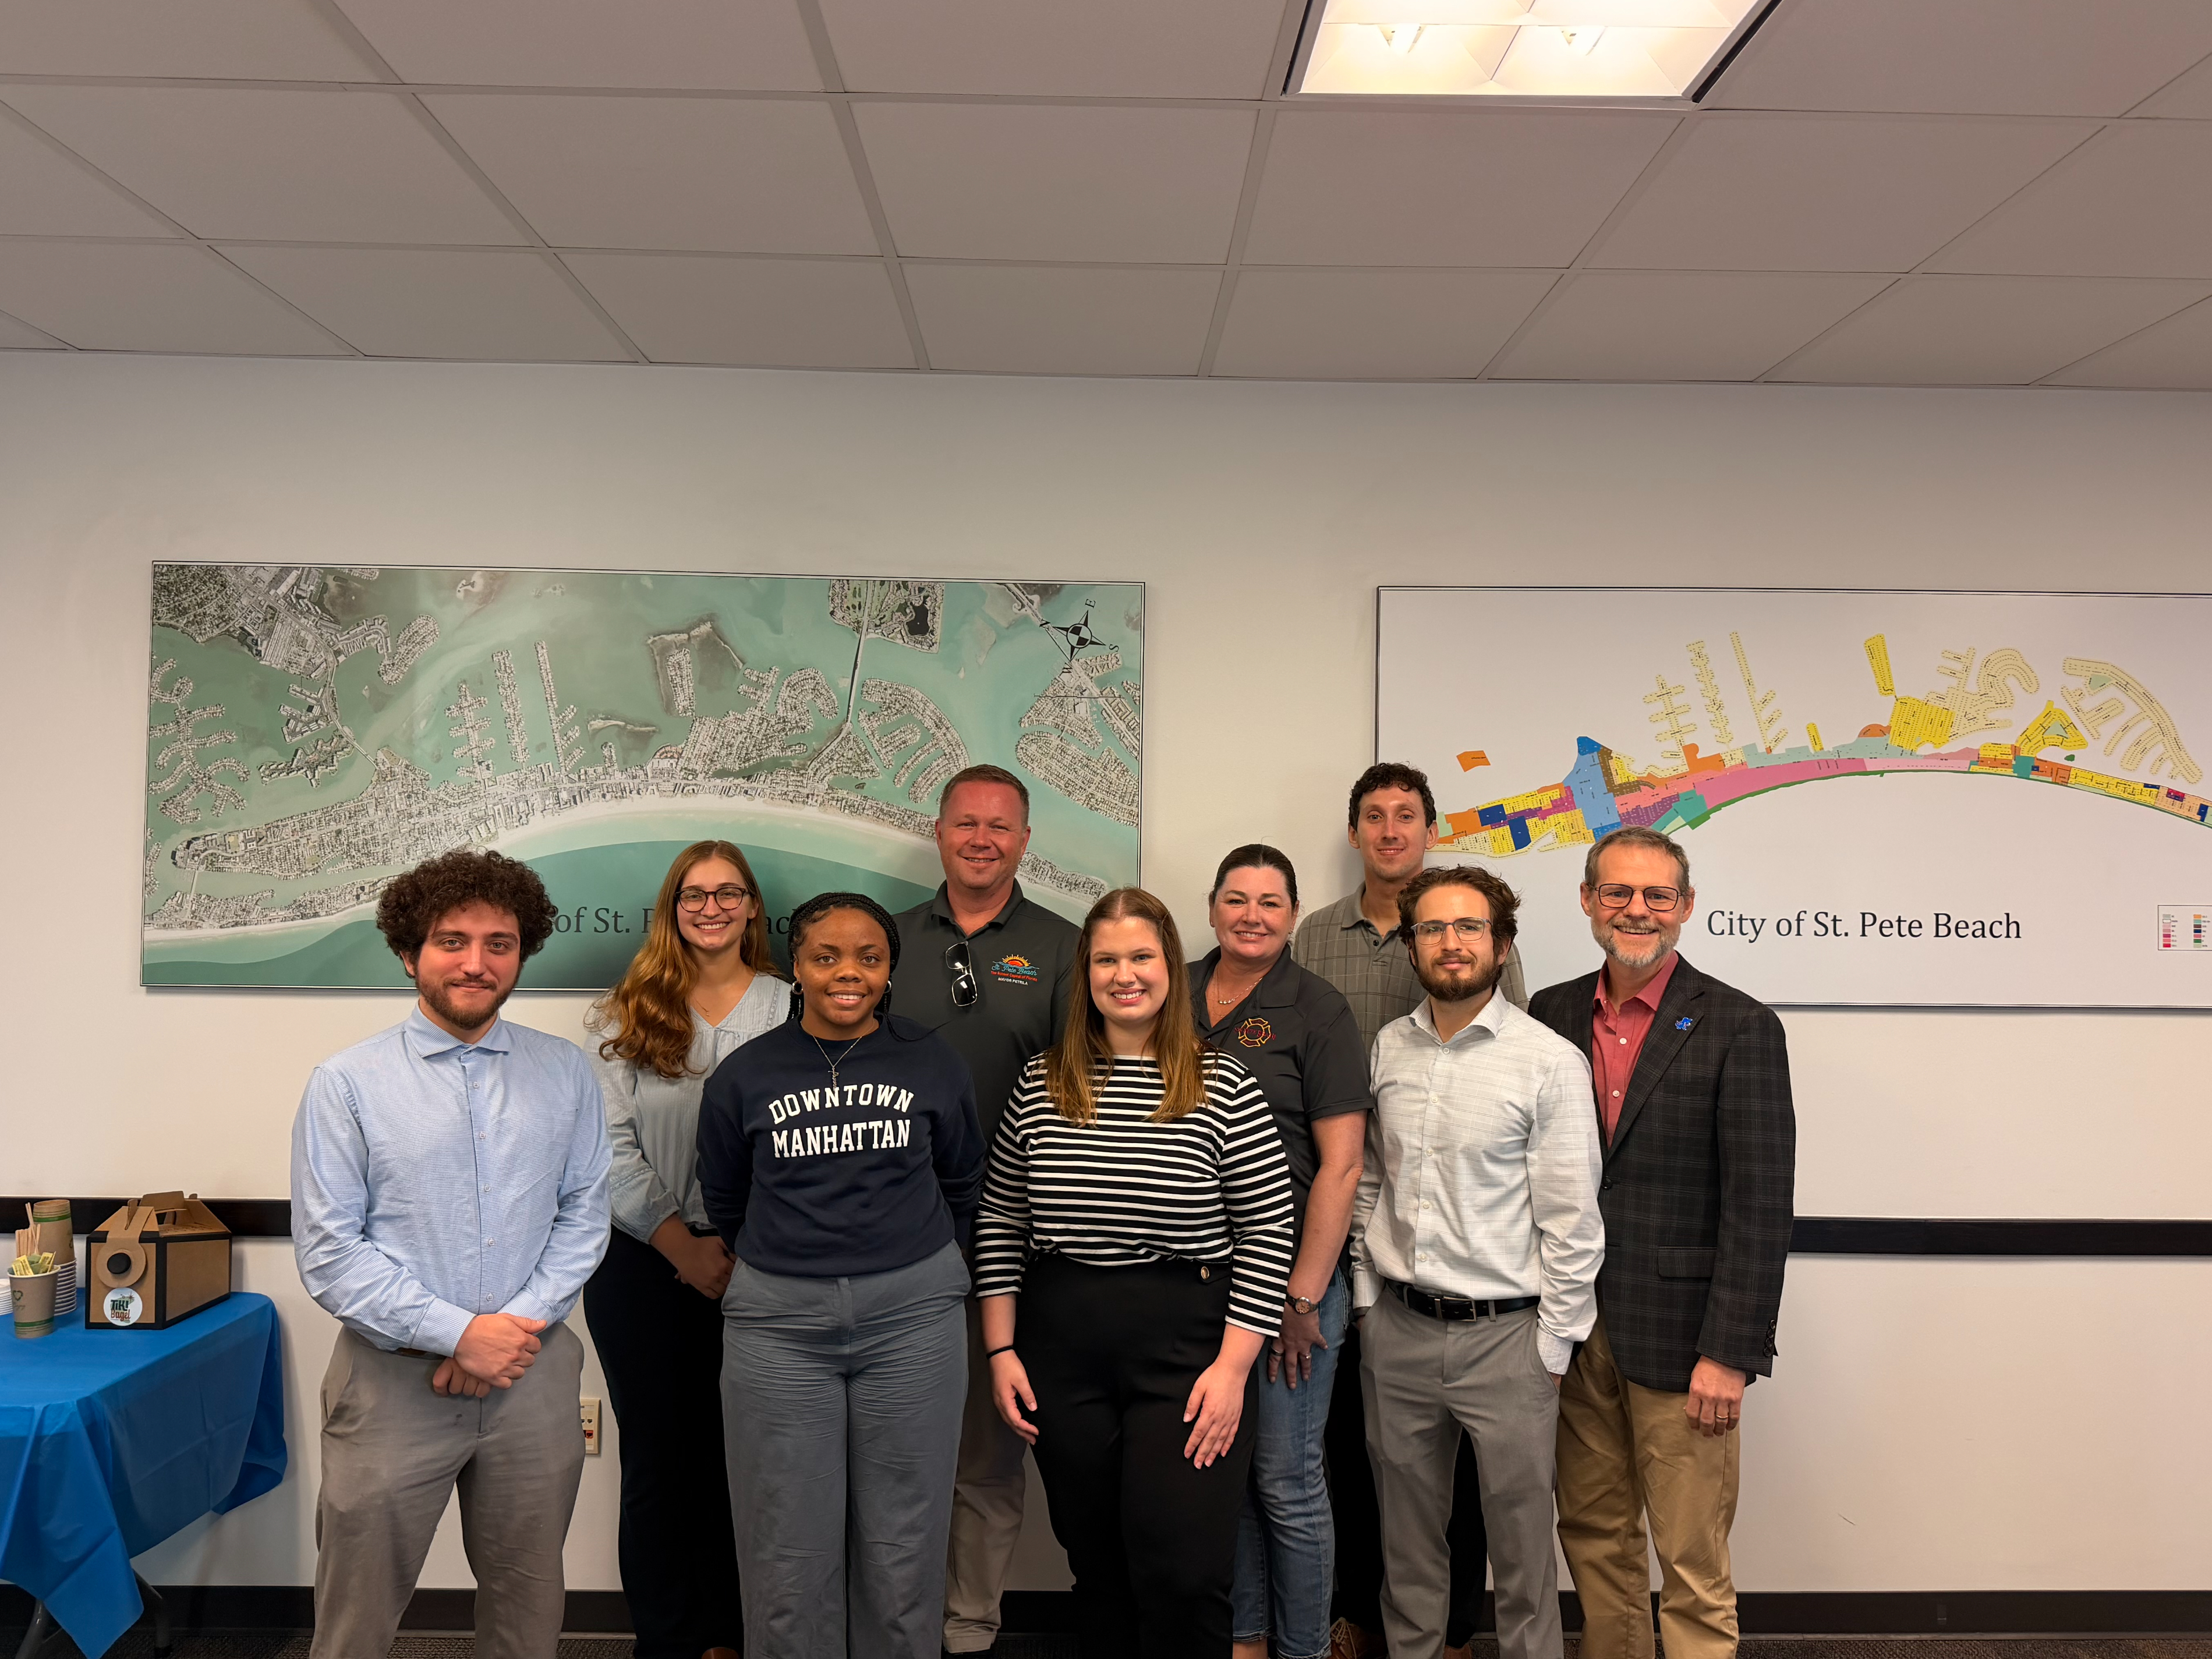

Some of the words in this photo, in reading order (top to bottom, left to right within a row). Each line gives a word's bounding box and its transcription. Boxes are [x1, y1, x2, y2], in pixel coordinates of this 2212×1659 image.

[555, 906, 587, 933] of
[594, 908, 629, 933] St.
[1707, 910, 1767, 943] City
[1776, 910, 1807, 936] of
[1814, 911, 1848, 937] St.
[1859, 912, 1923, 938] Pete
[1933, 912, 2022, 939] Beach
[1017, 968, 1038, 976] Beach
[768, 1083, 914, 1124] DOWNTOWN
[772, 1119, 910, 1158] MANHATTAN
[111, 1309, 131, 1322] Bagel
